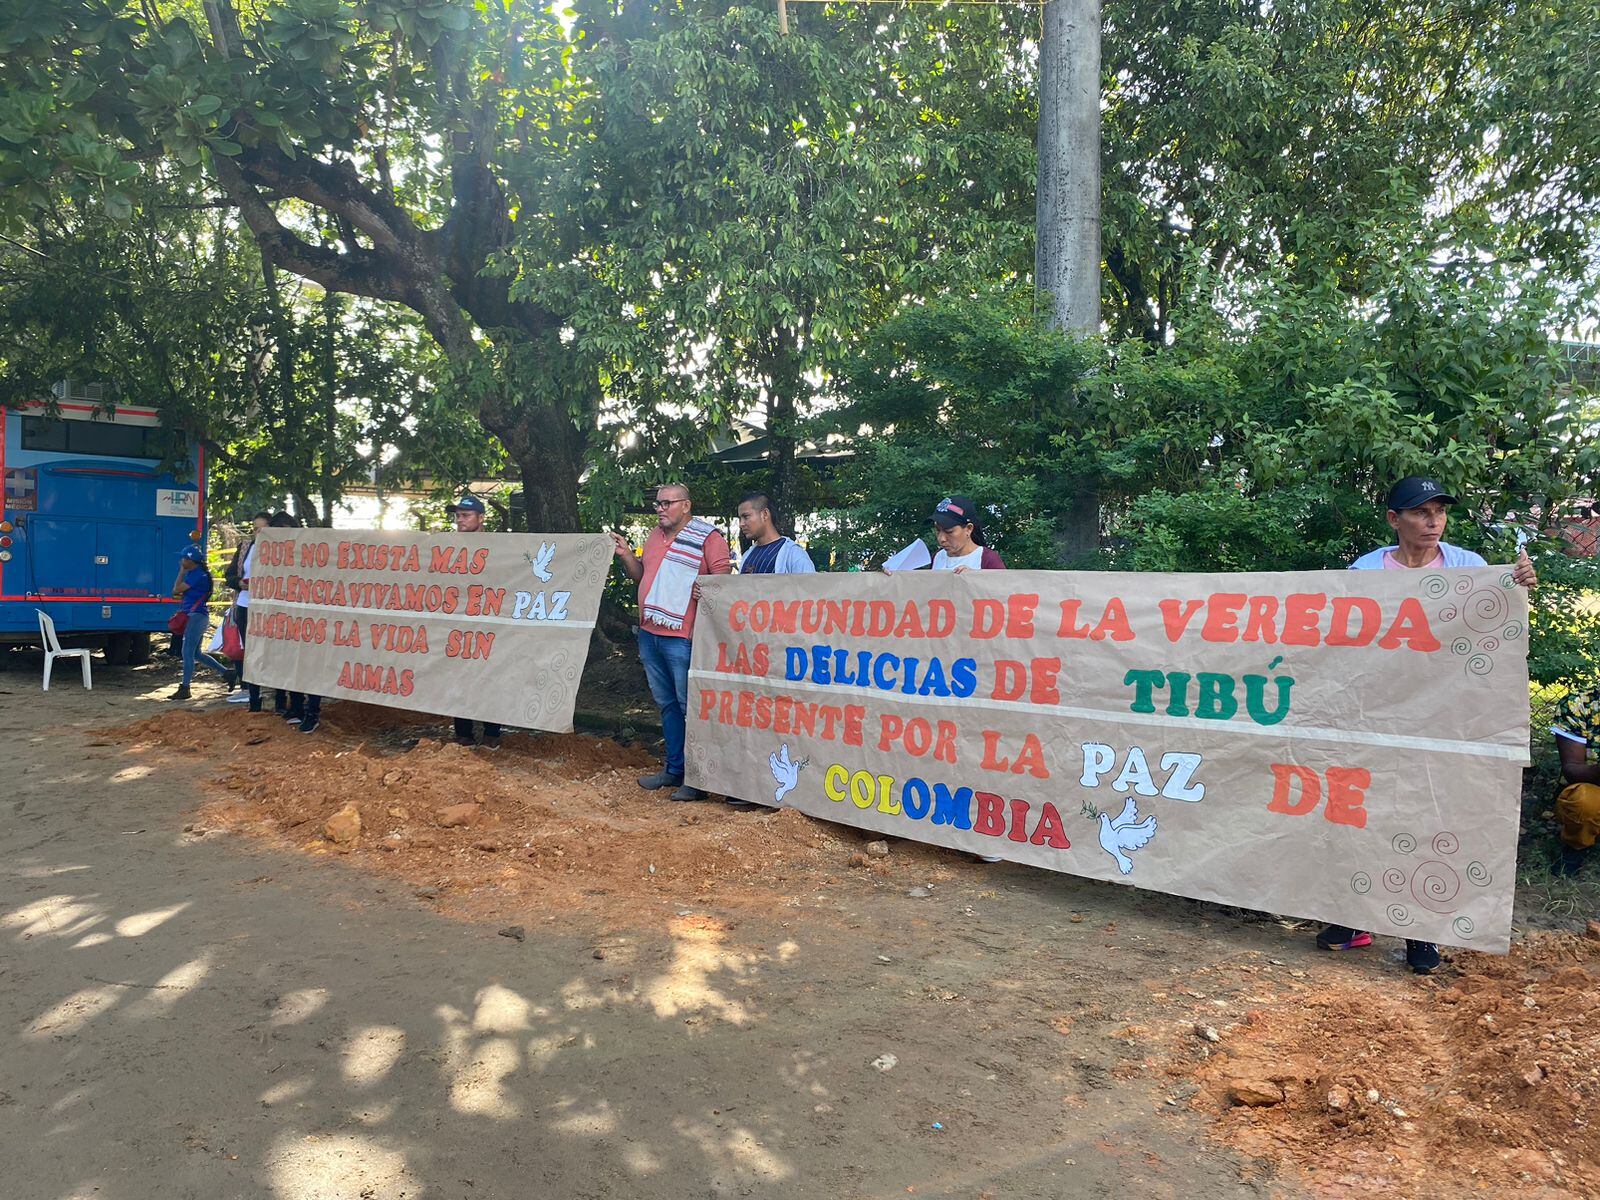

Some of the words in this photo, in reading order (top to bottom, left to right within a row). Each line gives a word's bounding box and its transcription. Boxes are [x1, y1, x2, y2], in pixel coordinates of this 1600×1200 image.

[259, 540, 296, 567] QUE
[301, 543, 329, 568] NO
[337, 541, 420, 572] EXISTA
[428, 546, 489, 575] MAS
[464, 585, 506, 616] EN
[511, 591, 571, 621] PAZ
[728, 599, 956, 638] COMUNIDAD
[969, 593, 1039, 639] DE
[1056, 597, 1135, 641] LA
[1158, 592, 1441, 652] VEREDA
[333, 620, 360, 648] LA
[370, 624, 428, 654] VIDA
[446, 629, 495, 660] SIN
[337, 662, 415, 696] ARMAS
[715, 643, 769, 676] LAS
[785, 645, 977, 698] DELICIAS
[990, 657, 1062, 704] DE
[1123, 656, 1295, 726] TIBÚ
[699, 690, 866, 746] PRESENTE
[878, 714, 957, 764] POR
[980, 730, 1050, 779] LA
[1079, 742, 1205, 803] PAZ
[1267, 764, 1372, 828] DE
[824, 764, 1071, 849] COLOMBIA
